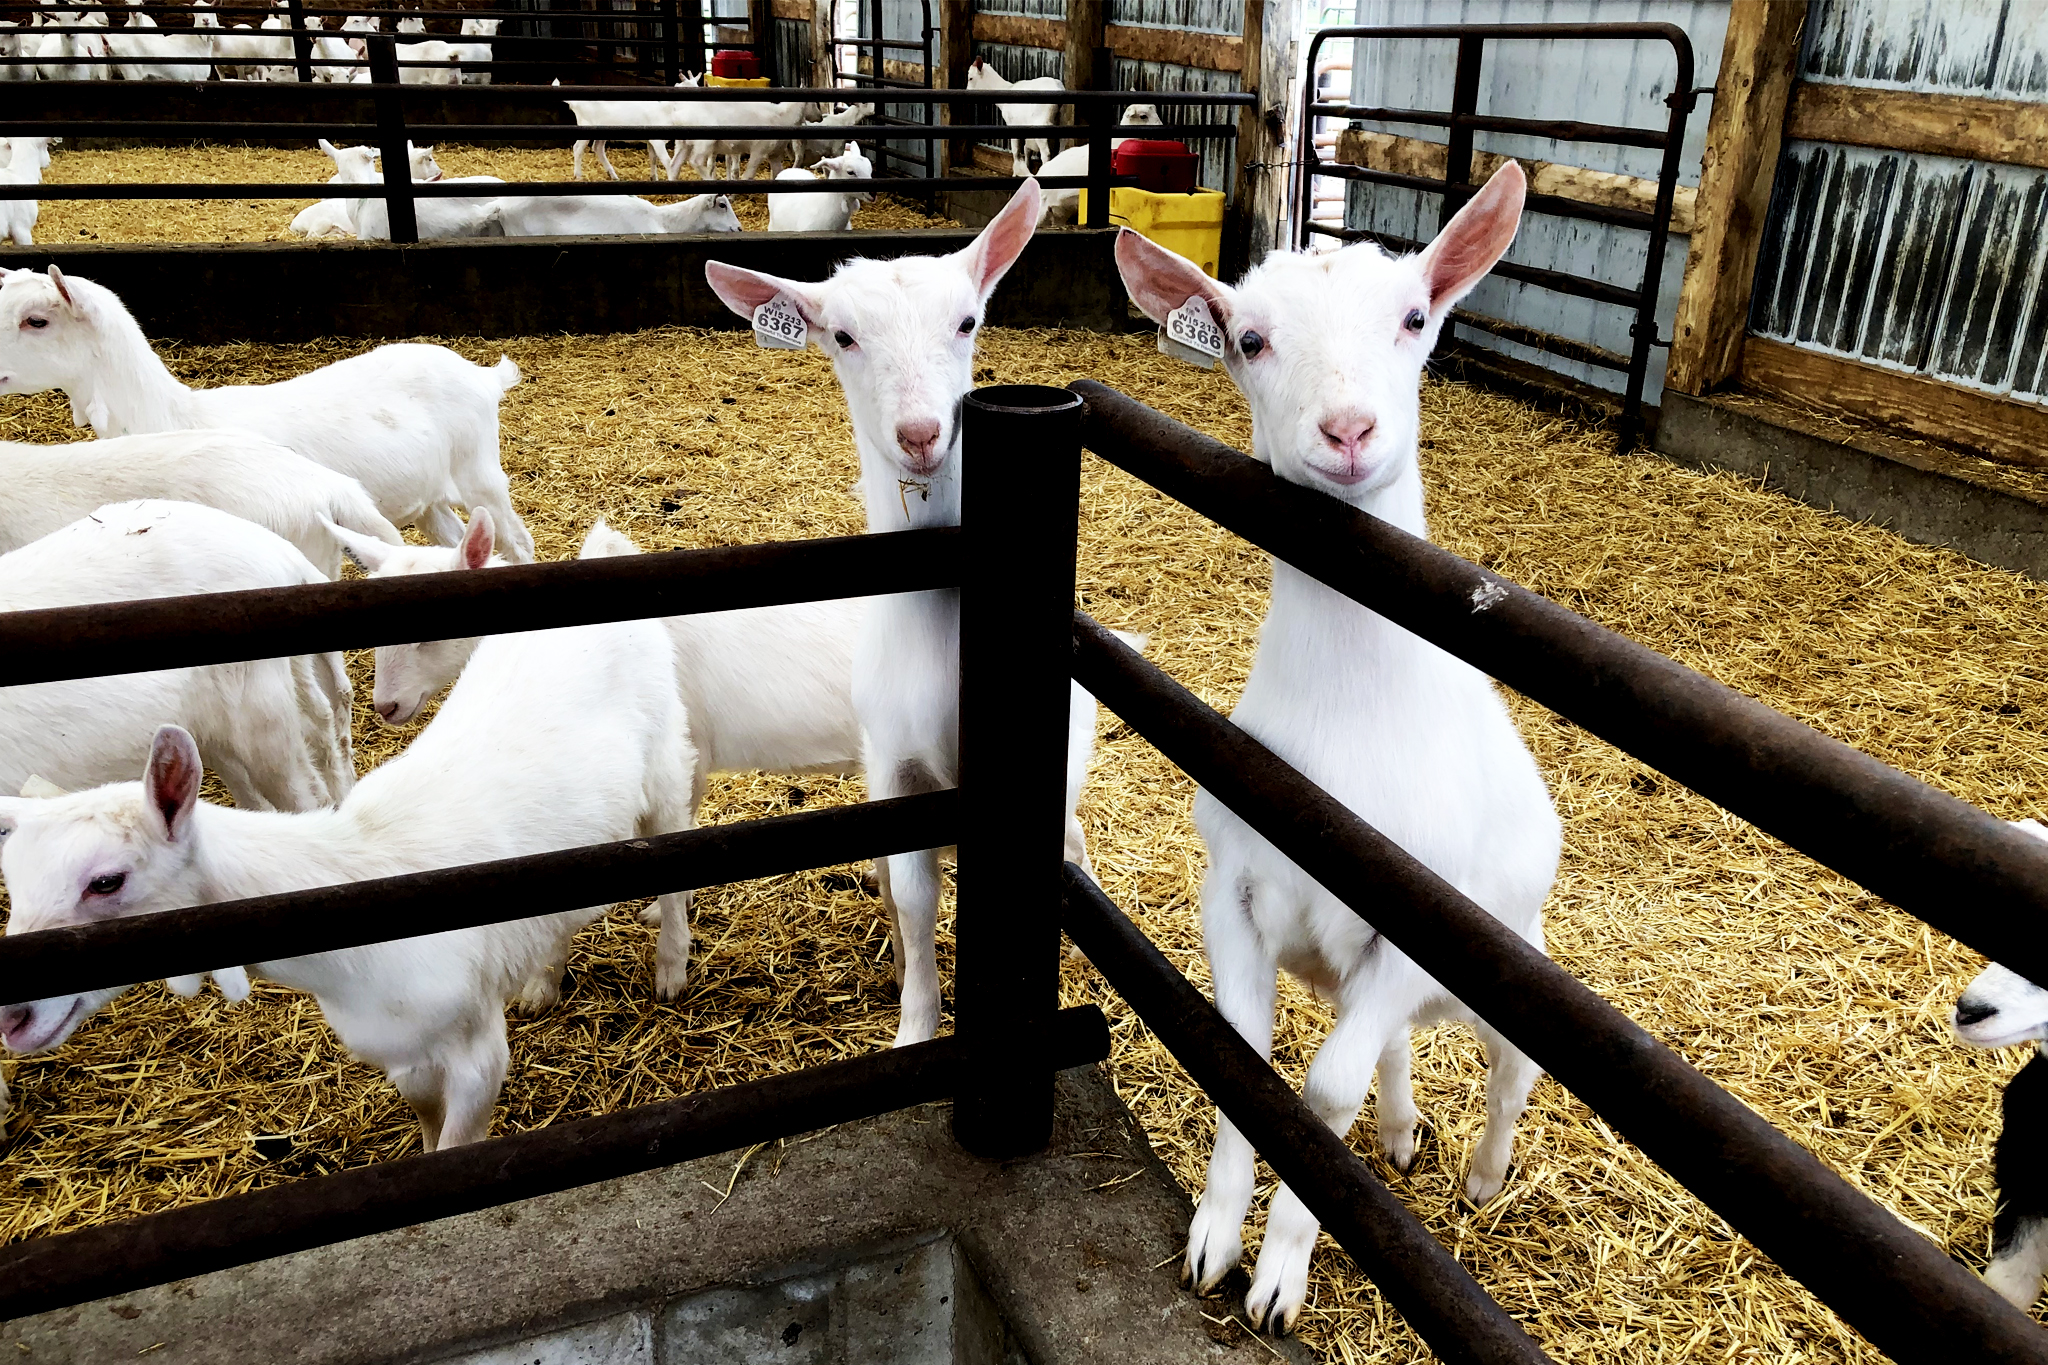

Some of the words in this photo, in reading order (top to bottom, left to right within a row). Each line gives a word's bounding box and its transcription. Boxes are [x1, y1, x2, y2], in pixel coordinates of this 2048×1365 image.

[758, 314, 804, 338] 6367
[764, 306, 801, 325] WI5213
[1178, 312, 1218, 334] WI5213
[1173, 320, 1221, 349] 6366
